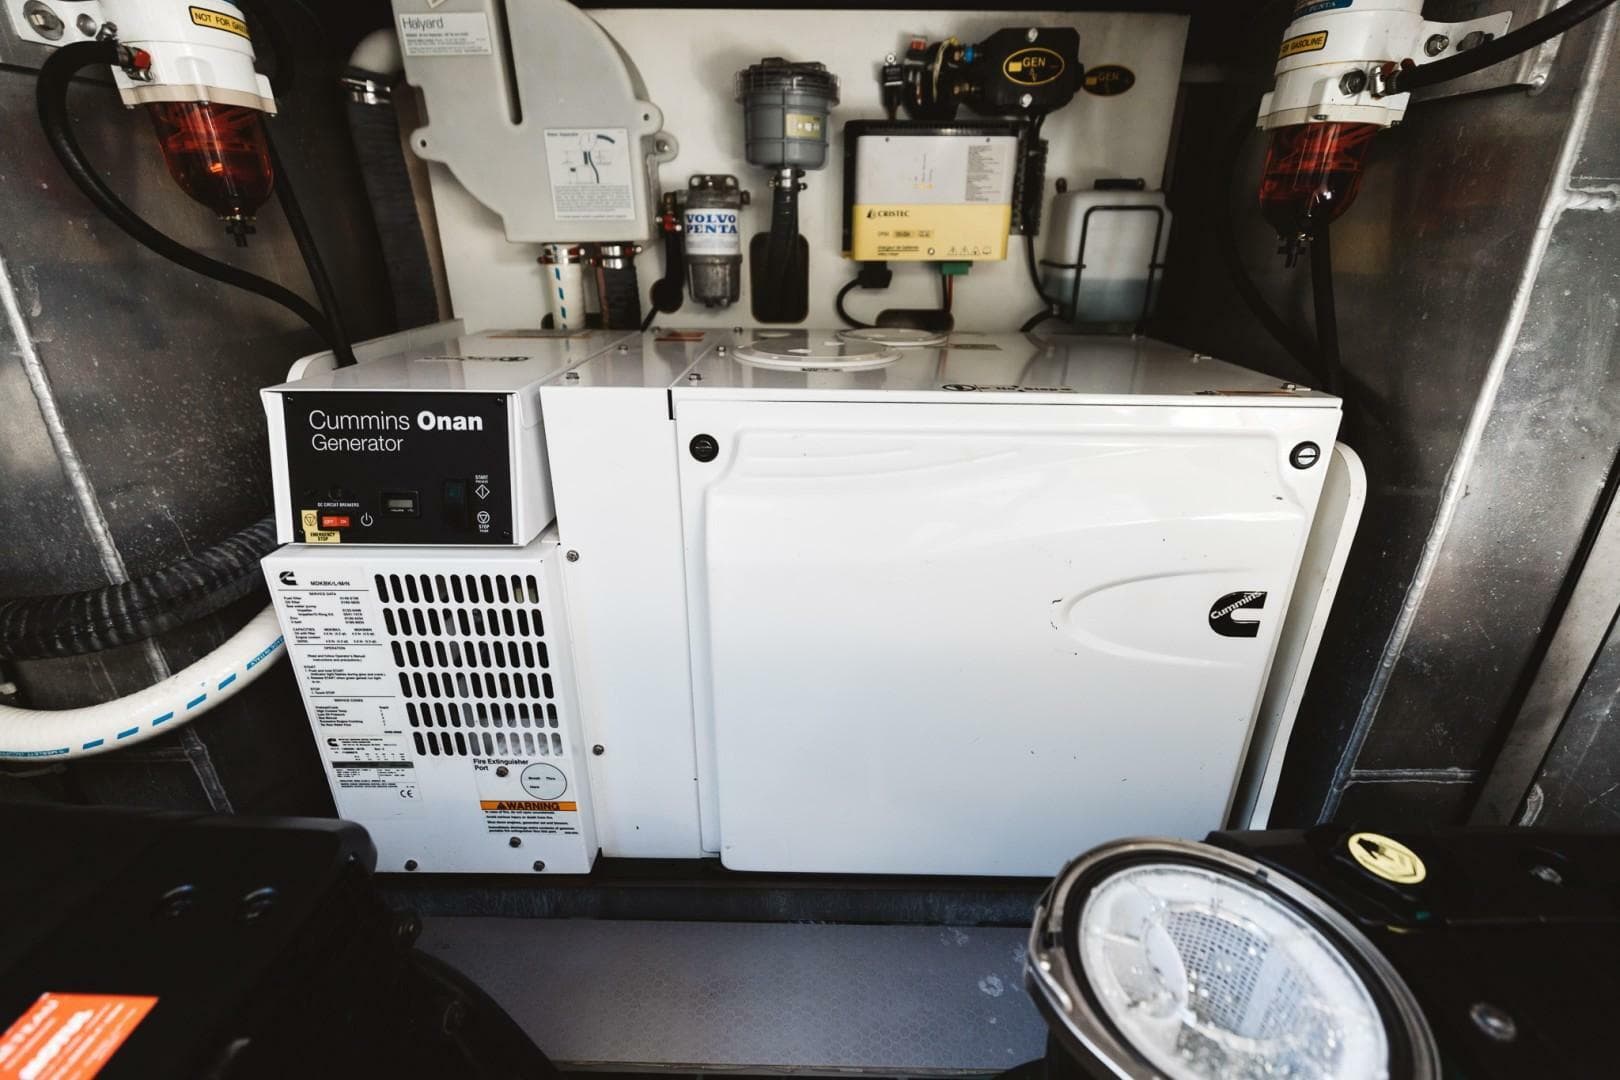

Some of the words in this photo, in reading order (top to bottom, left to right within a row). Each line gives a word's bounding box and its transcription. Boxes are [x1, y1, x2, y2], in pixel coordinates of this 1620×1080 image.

[194, 12, 212, 23] NOT
[216, 16, 230, 26] FOR
[402, 16, 444, 32] Halyard
[1290, 36, 1324, 50] GASOLINE
[1022, 57, 1046, 68] GEN
[686, 214, 737, 223] VOLVO
[686, 224, 738, 234] PENTA
[308, 410, 410, 431] Cummins
[416, 410, 483, 431] Onan
[311, 434, 404, 452] Generator
[1210, 592, 1263, 619] Cummins
[506, 801, 560, 811] WARNING
